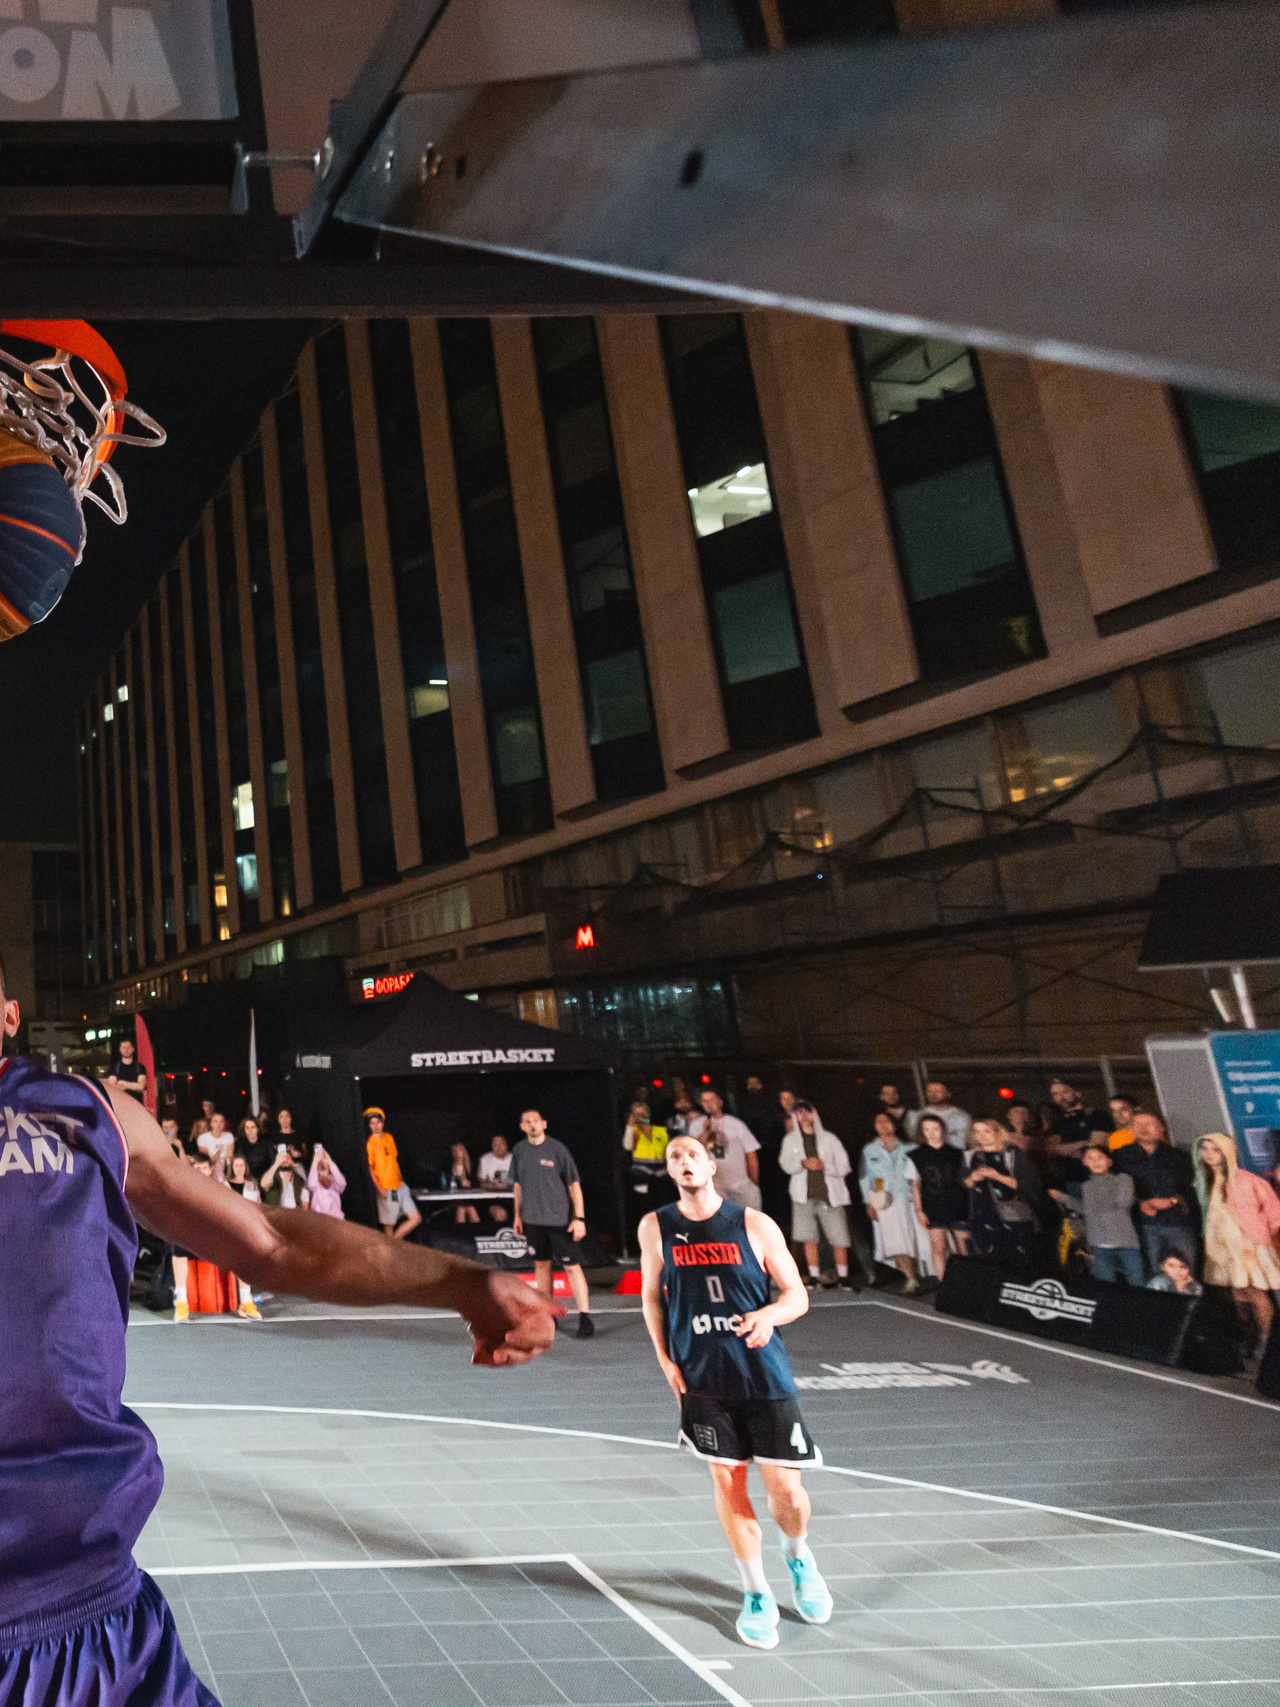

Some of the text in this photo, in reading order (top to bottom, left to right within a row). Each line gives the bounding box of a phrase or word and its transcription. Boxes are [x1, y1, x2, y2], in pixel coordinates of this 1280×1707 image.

[375, 972, 414, 994] ФОРАБ
[411, 1048, 555, 1067] STREETBASKET
[672, 1243, 742, 1267] RUSSIA
